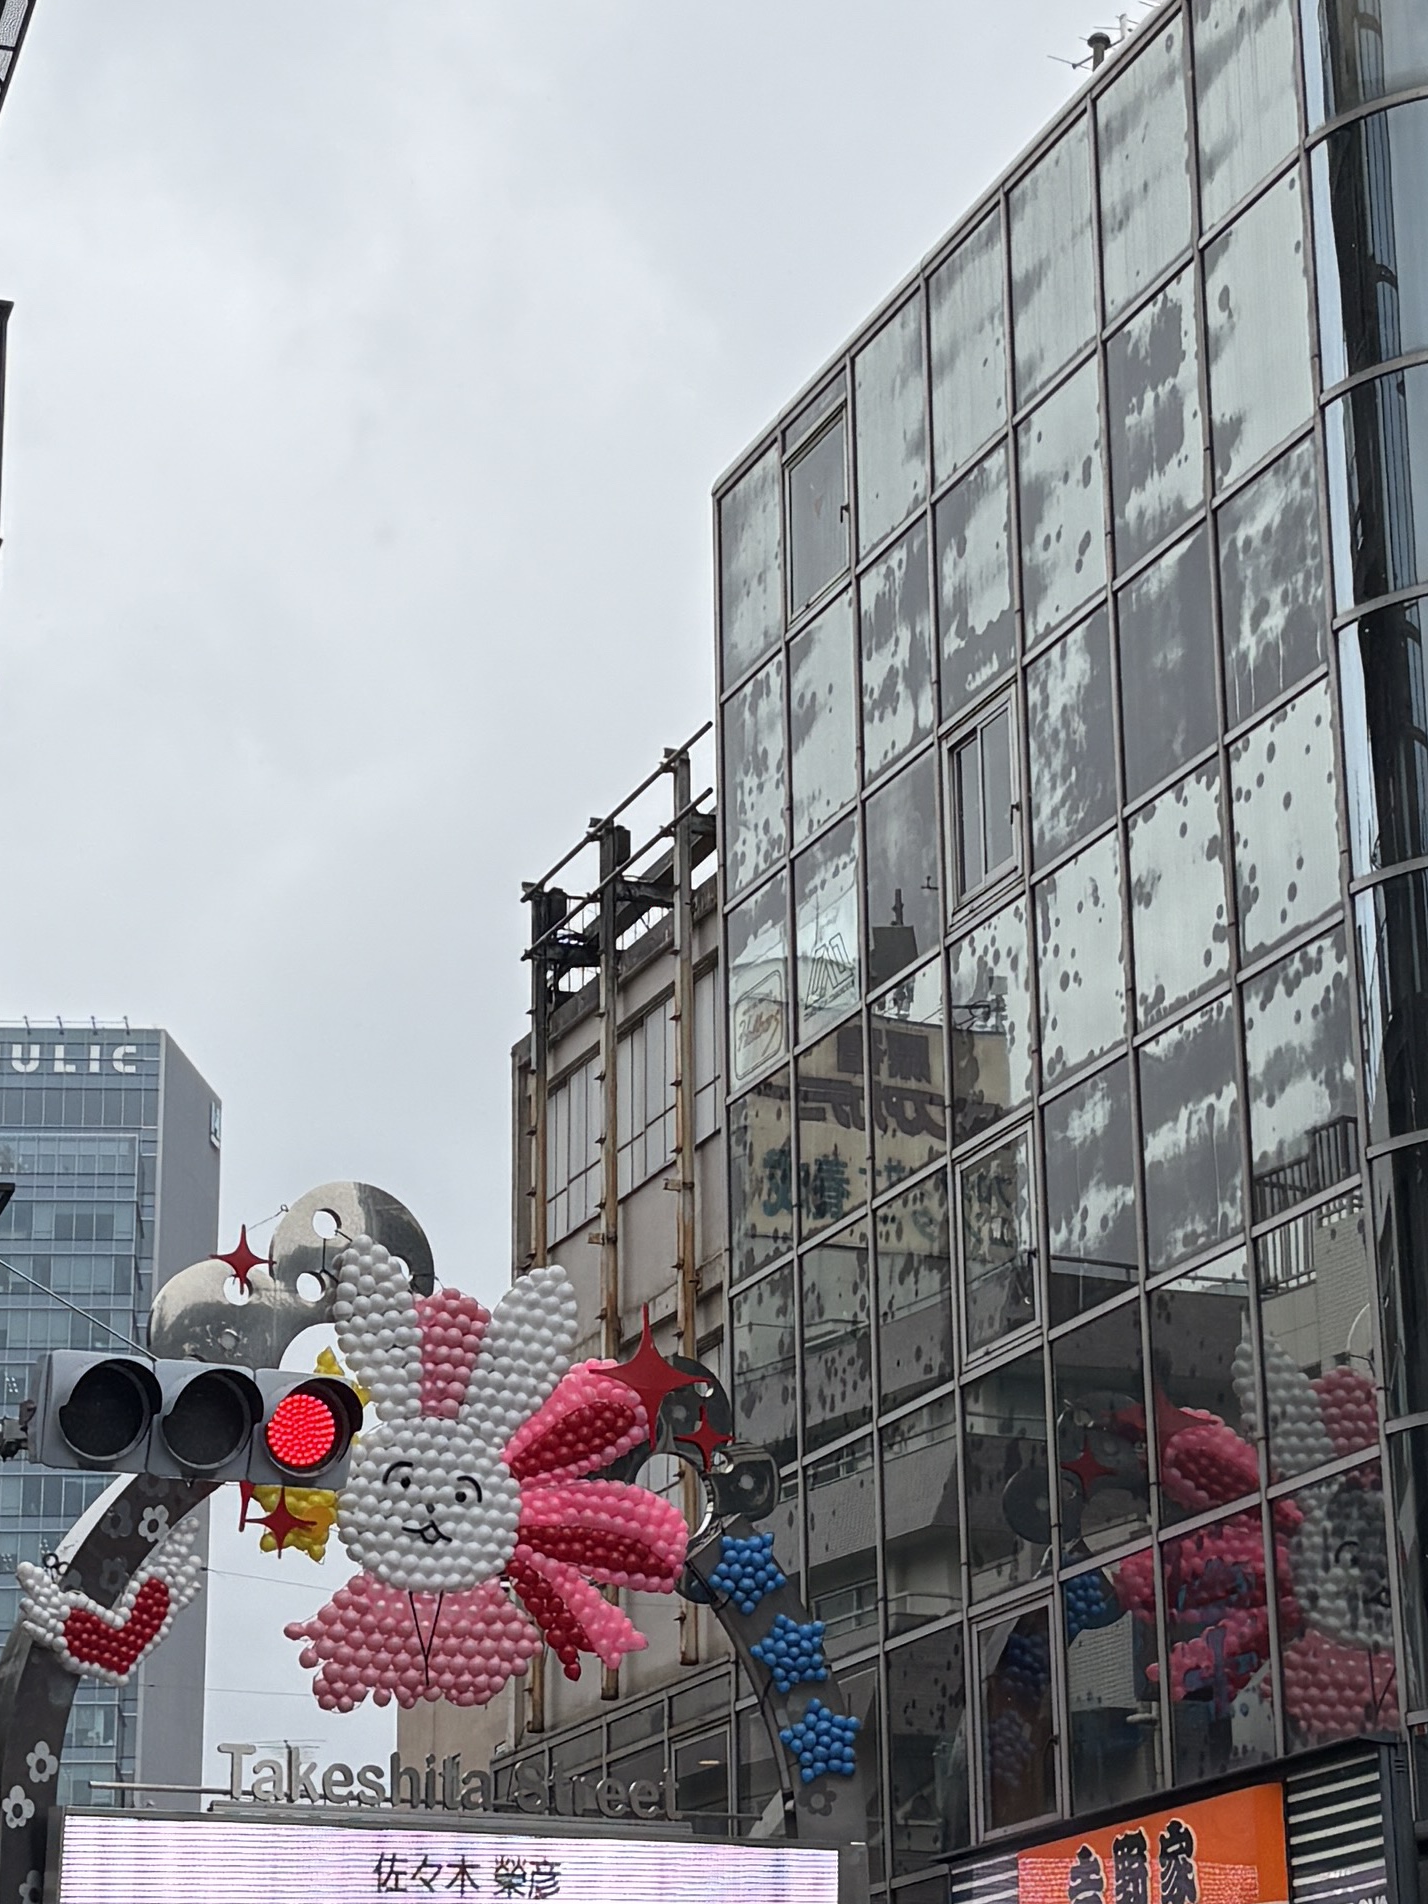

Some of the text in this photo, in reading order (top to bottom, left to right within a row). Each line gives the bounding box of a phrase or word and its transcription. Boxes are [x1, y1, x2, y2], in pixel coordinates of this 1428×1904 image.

[217, 1741, 681, 1820] Takeshita Street
[373, 1851, 480, 1895] 佐々木
